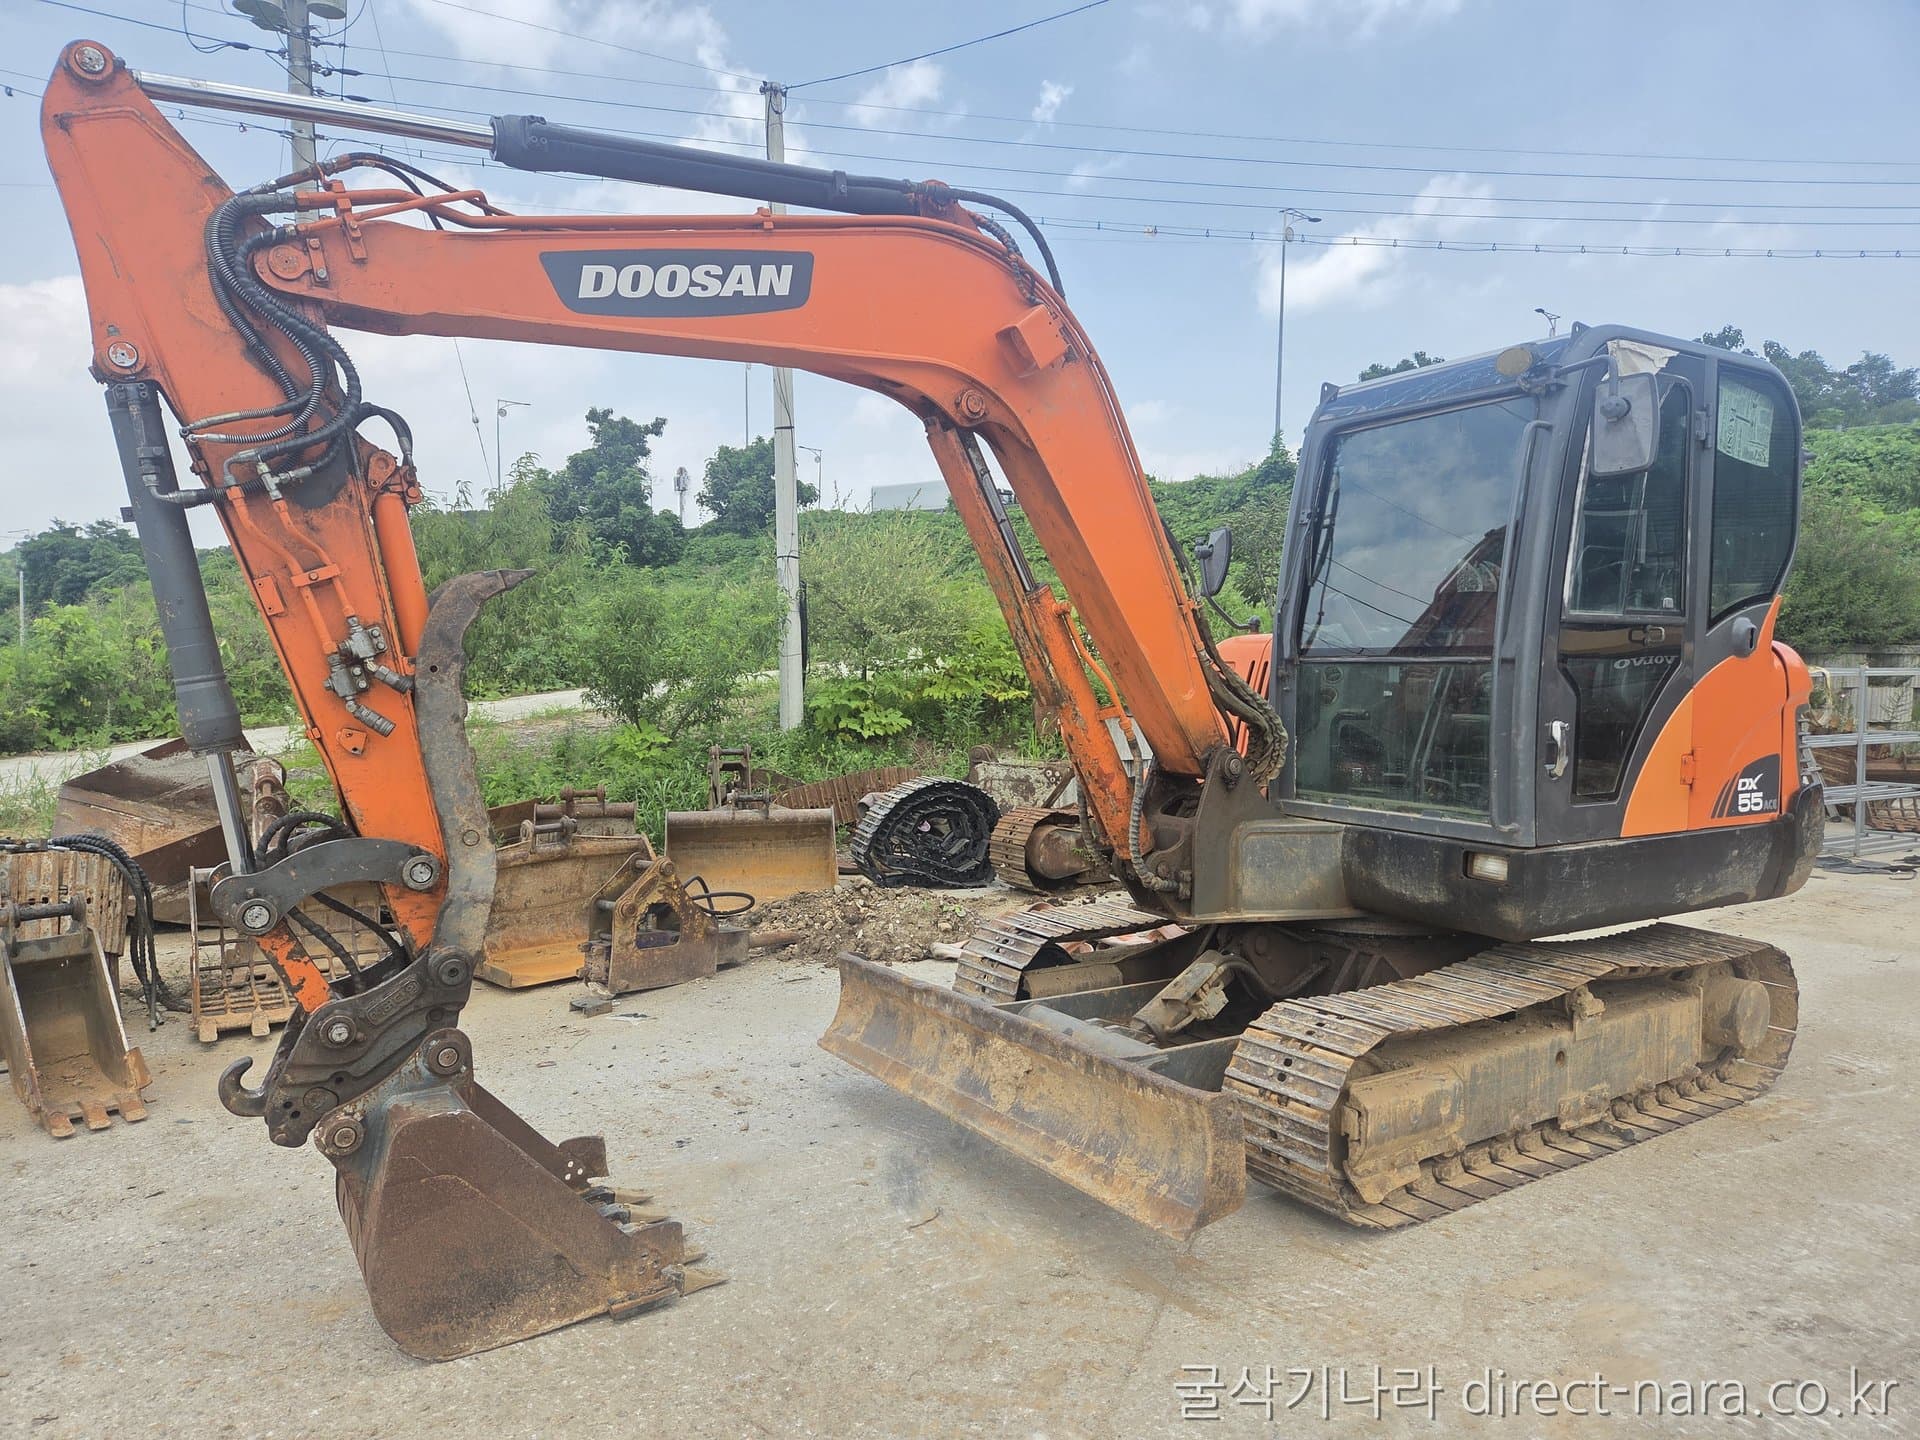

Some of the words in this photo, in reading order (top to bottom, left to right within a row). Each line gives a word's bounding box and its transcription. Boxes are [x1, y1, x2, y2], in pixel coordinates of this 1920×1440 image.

[578, 264, 793, 298] DOOSAN
[1737, 773, 1764, 791] DX
[1738, 791, 1763, 813] 55
